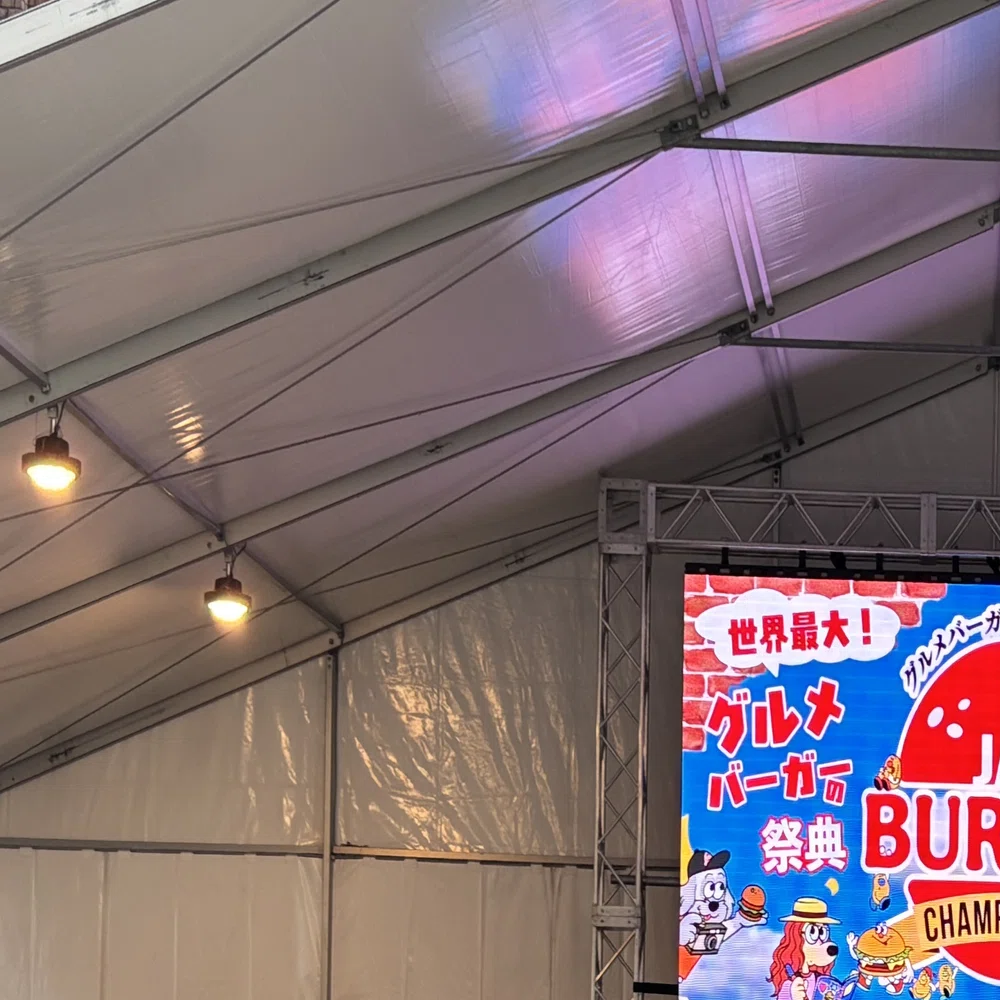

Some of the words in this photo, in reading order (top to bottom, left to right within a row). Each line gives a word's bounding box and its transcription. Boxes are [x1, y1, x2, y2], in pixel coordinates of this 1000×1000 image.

[706, 677, 845, 758] グルメ
[761, 815, 847, 873] 祭典
